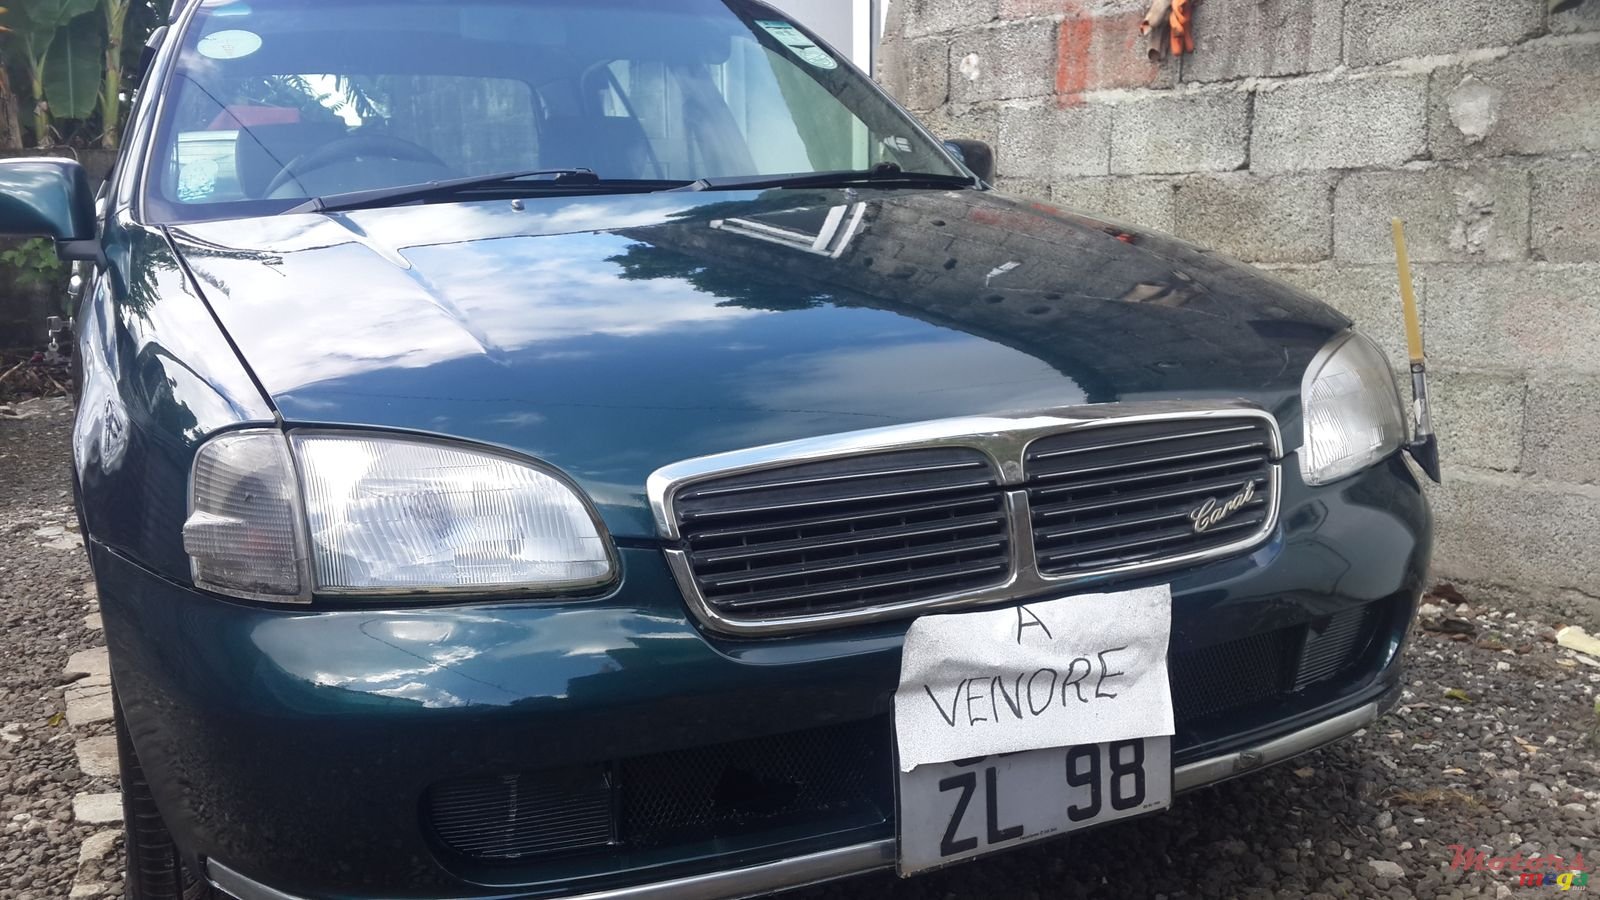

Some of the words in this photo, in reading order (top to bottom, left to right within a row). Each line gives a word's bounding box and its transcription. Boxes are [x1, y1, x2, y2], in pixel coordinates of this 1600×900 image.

[1190, 480, 1254, 532] Carat
[1016, 605, 1053, 645] A
[938, 766, 1024, 857] ZL
[1066, 737, 1146, 822] 98
